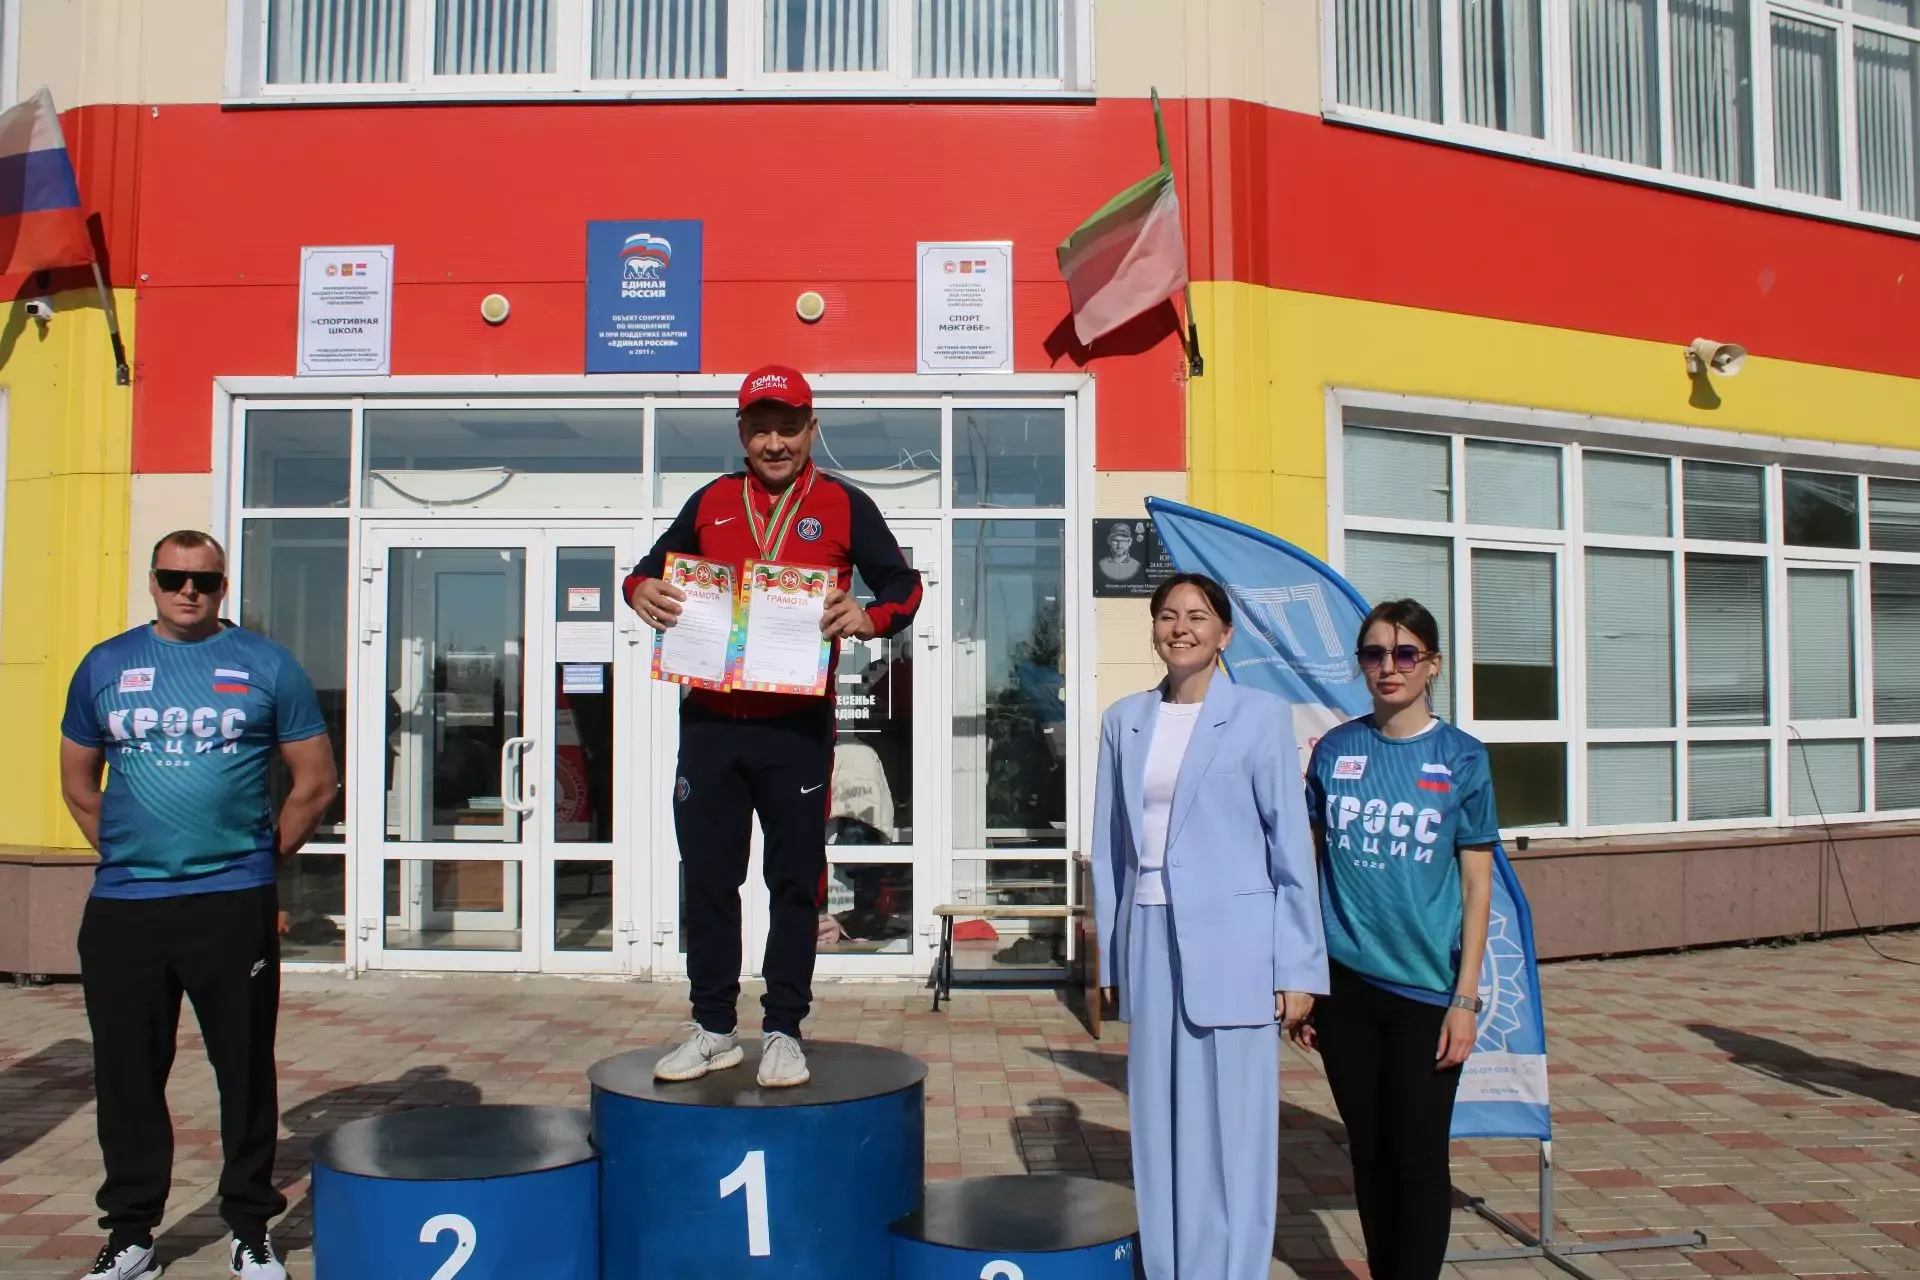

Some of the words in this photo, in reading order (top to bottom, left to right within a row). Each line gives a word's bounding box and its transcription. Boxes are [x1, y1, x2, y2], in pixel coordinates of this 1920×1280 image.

[622, 281, 666, 290] ЕДИНАЯ
[622, 290, 666, 298] РОССИЯ
[751, 374, 788, 389] TOMMY
[763, 382, 788, 390] JEANS
[684, 589, 721, 601] ГРАМОТА
[766, 594, 809, 606] ГРАМОТА
[836, 695, 876, 706] ЕСЕНЬЕ
[108, 706, 247, 741] КРОСС
[121, 740, 238, 755] НАЦИИ
[719, 1150, 770, 1256] 1
[419, 1213, 477, 1280] 2
